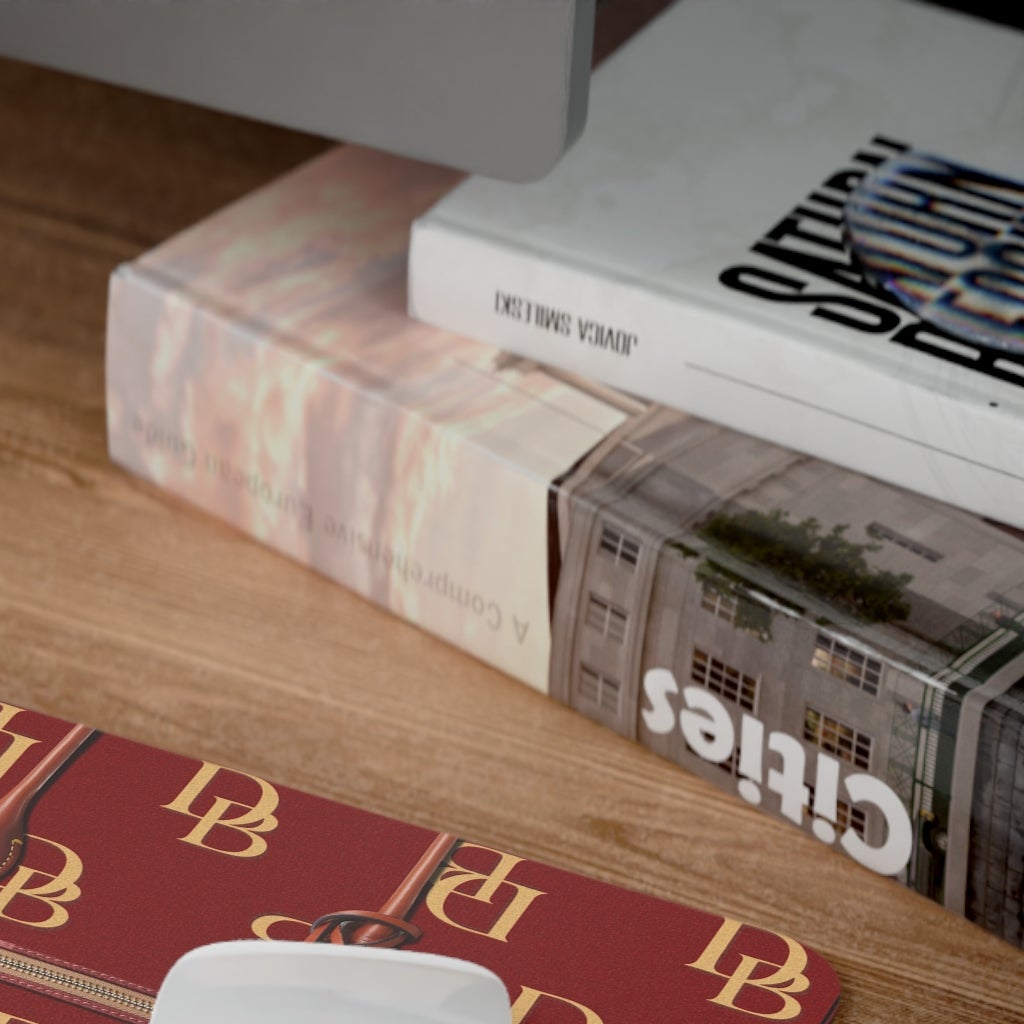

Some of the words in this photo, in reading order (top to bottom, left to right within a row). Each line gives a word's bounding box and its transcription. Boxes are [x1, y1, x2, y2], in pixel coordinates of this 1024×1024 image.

[495, 289, 571, 337] SMILESKI
[577, 315, 638, 357] JOVICA
[513, 612, 530, 645] A
[642, 668, 912, 875] Cities
